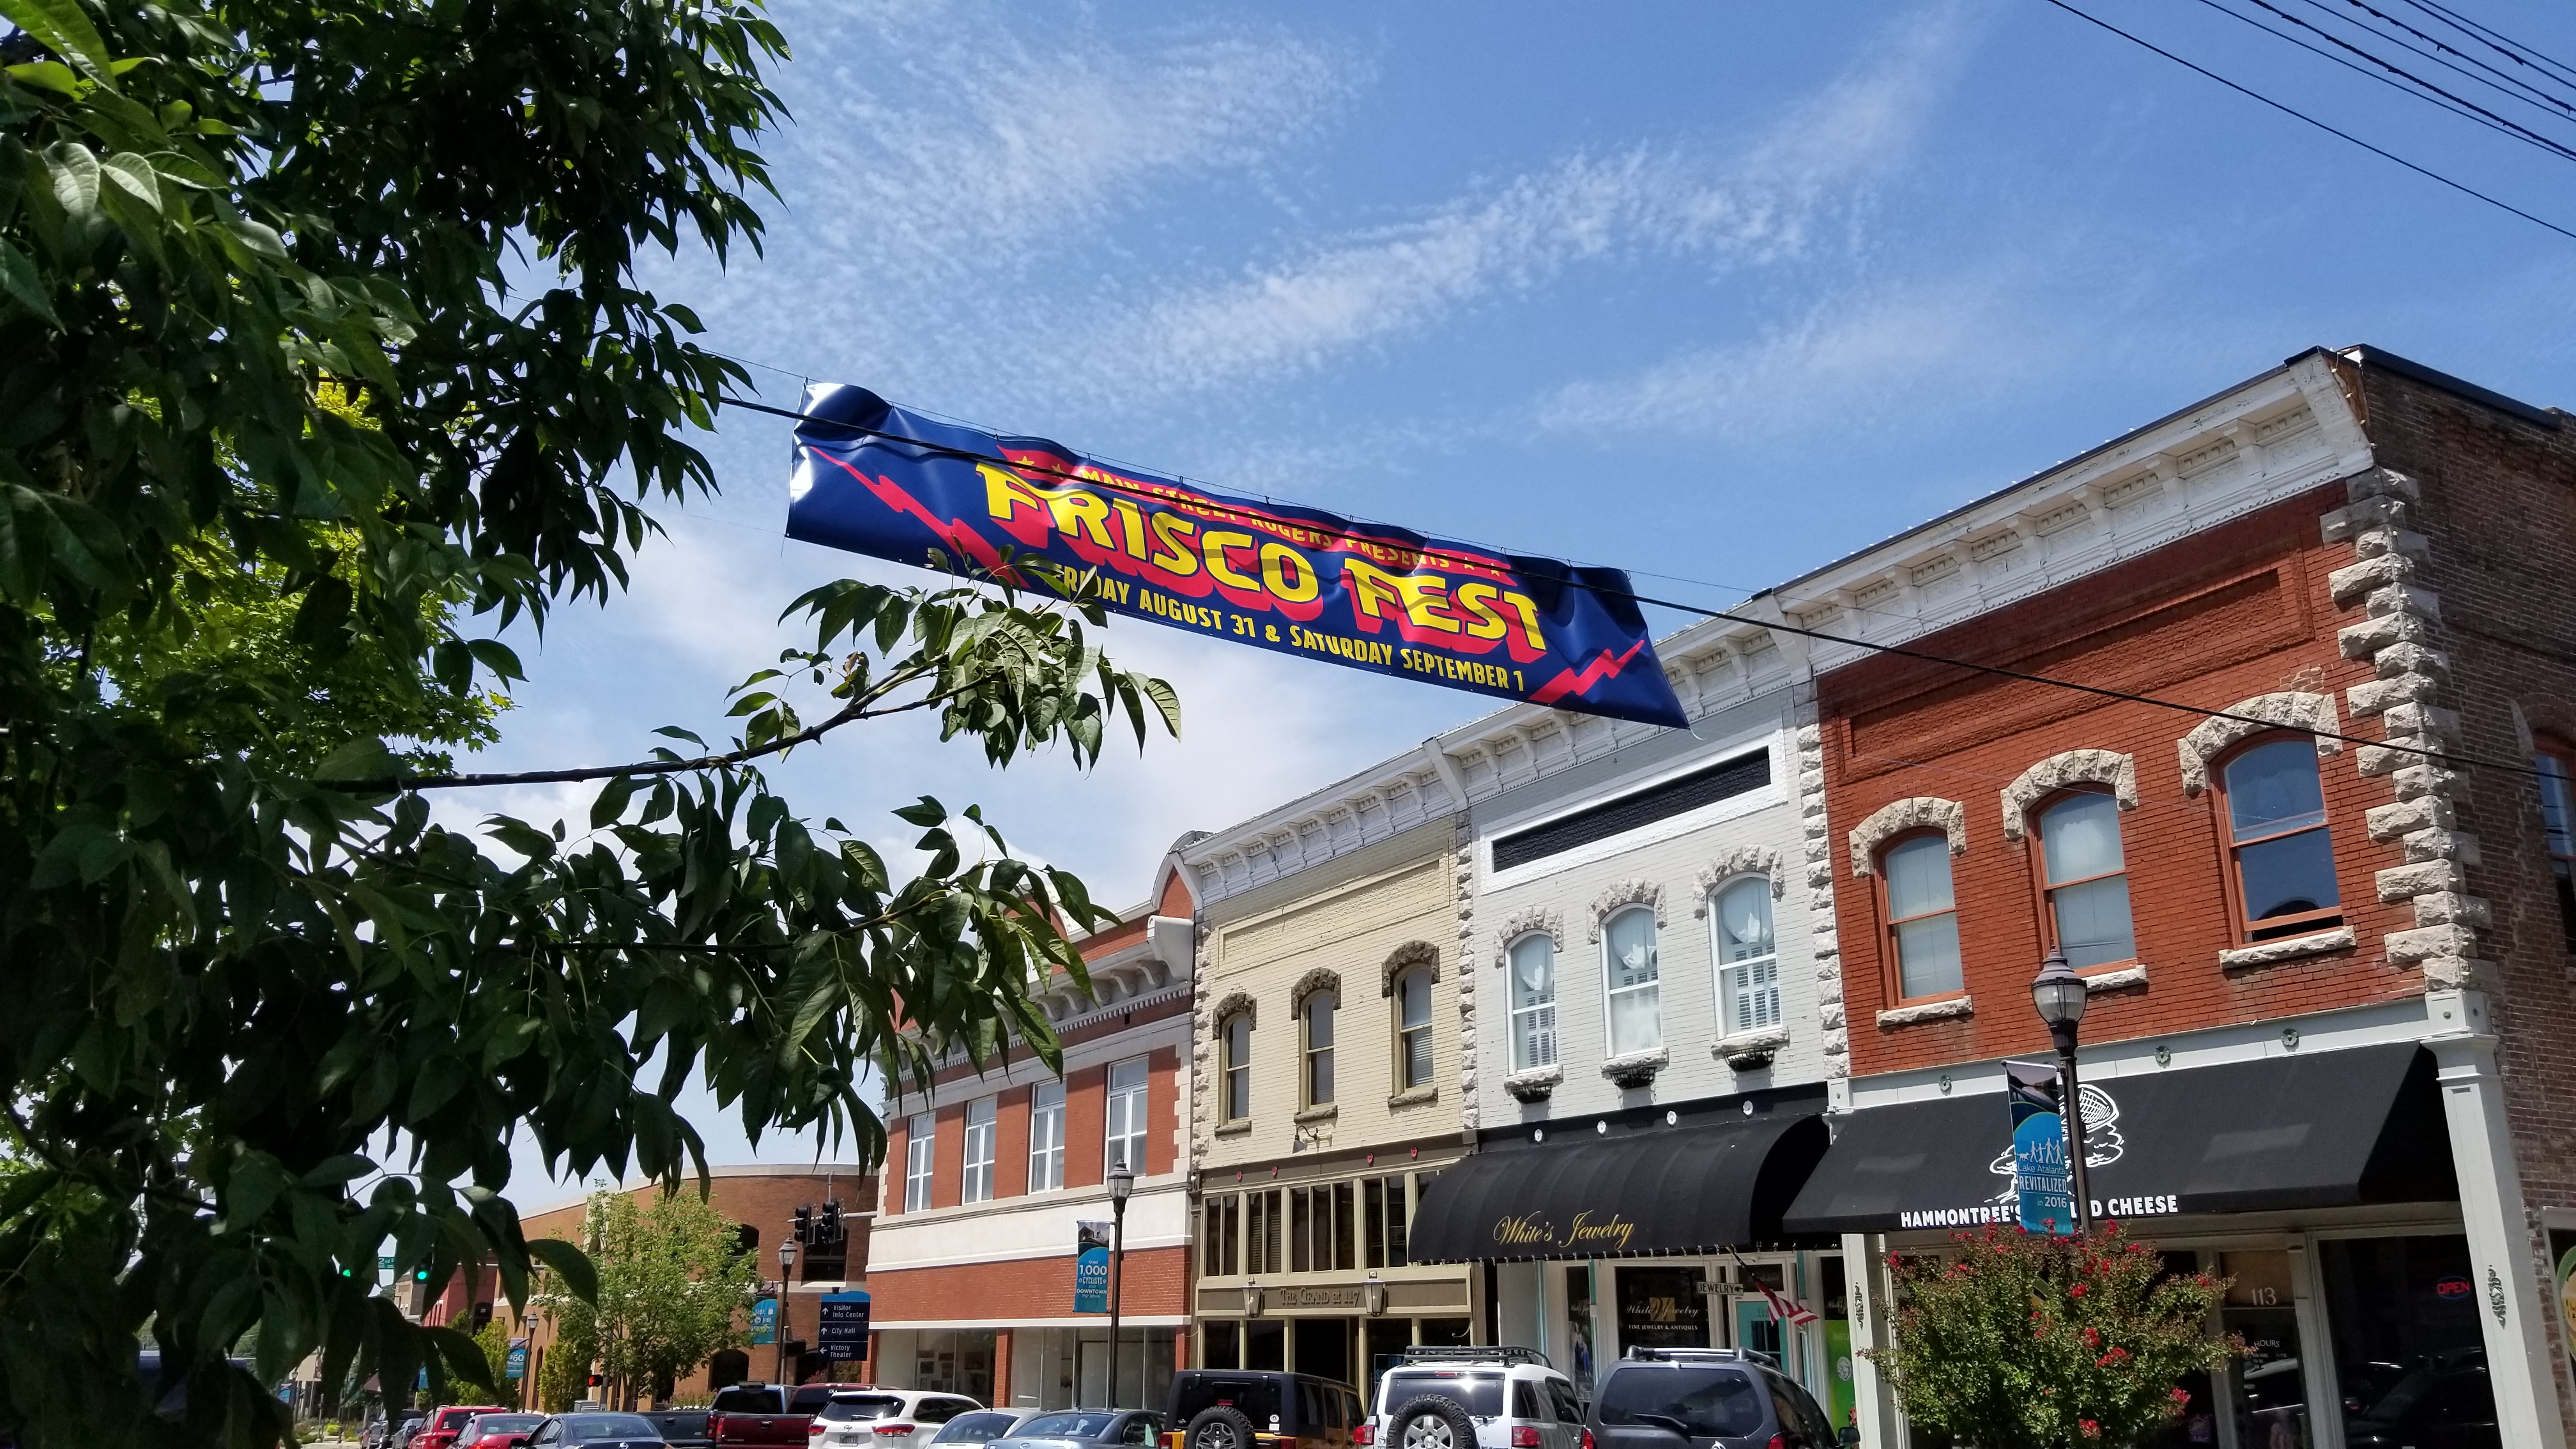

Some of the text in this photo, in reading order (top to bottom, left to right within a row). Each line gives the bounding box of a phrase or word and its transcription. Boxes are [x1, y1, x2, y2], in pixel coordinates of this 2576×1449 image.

[975, 462, 1547, 650] FRISCO FEST
[1139, 589, 1222, 631] AUGUST
[1230, 614, 1256, 638] 31
[1265, 624, 1281, 643] &
[1290, 625, 1393, 666] SATURDAY
[1402, 648, 1508, 687] SEPTEMBER
[1513, 670, 1524, 691] 1
[2018, 1163, 2066, 1176] Lake Atalanta
[2020, 1176, 2067, 1193] REVITALIZED
[2037, 1199, 2043, 1207] in
[2044, 1196, 2067, 1209] 2016
[2108, 1195, 2179, 1216] CHEESE
[1493, 1209, 1635, 1250] White's Jewelry
[1079, 1264, 1107, 1276] 1,000
[1082, 1276, 1103, 1285] CYCLISTS
[1699, 1283, 1735, 1294] JEWELRY
[2436, 1281, 2471, 1295] OPEN
[2251, 1287, 2277, 1306] 113
[831, 1327, 842, 1335] City
[2253, 1340, 2280, 1348] HOURS
